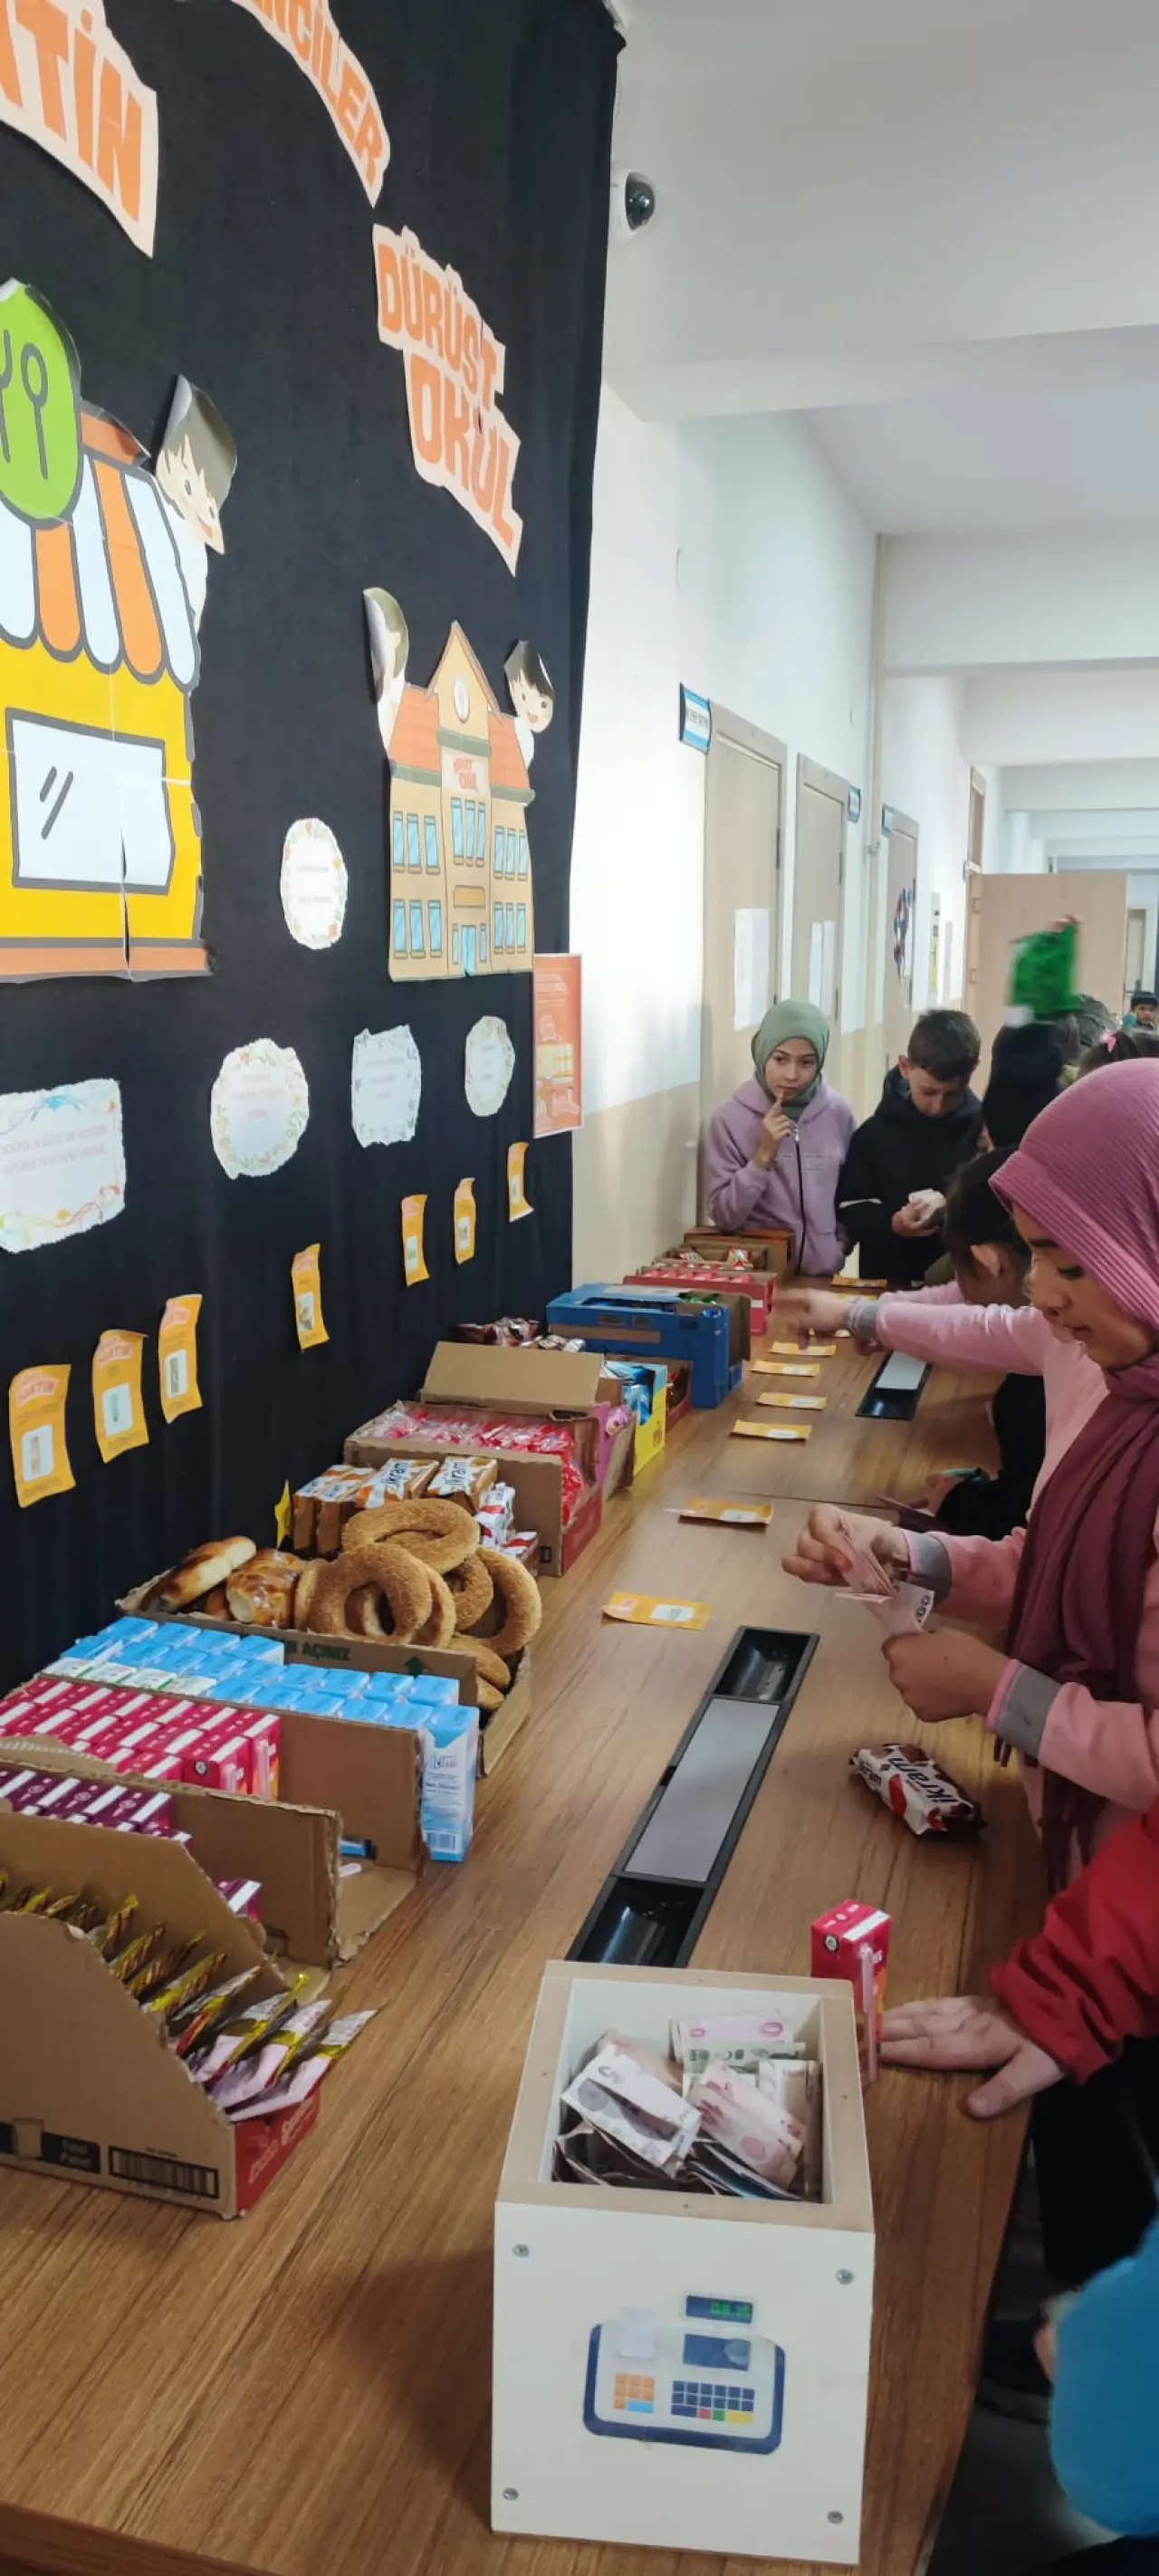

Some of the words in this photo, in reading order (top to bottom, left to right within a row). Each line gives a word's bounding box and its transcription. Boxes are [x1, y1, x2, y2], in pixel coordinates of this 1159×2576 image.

[377, 243, 498, 412] DÜRÜST
[410, 351, 514, 548] OKUL
[887, 1757, 958, 1803] ikram
